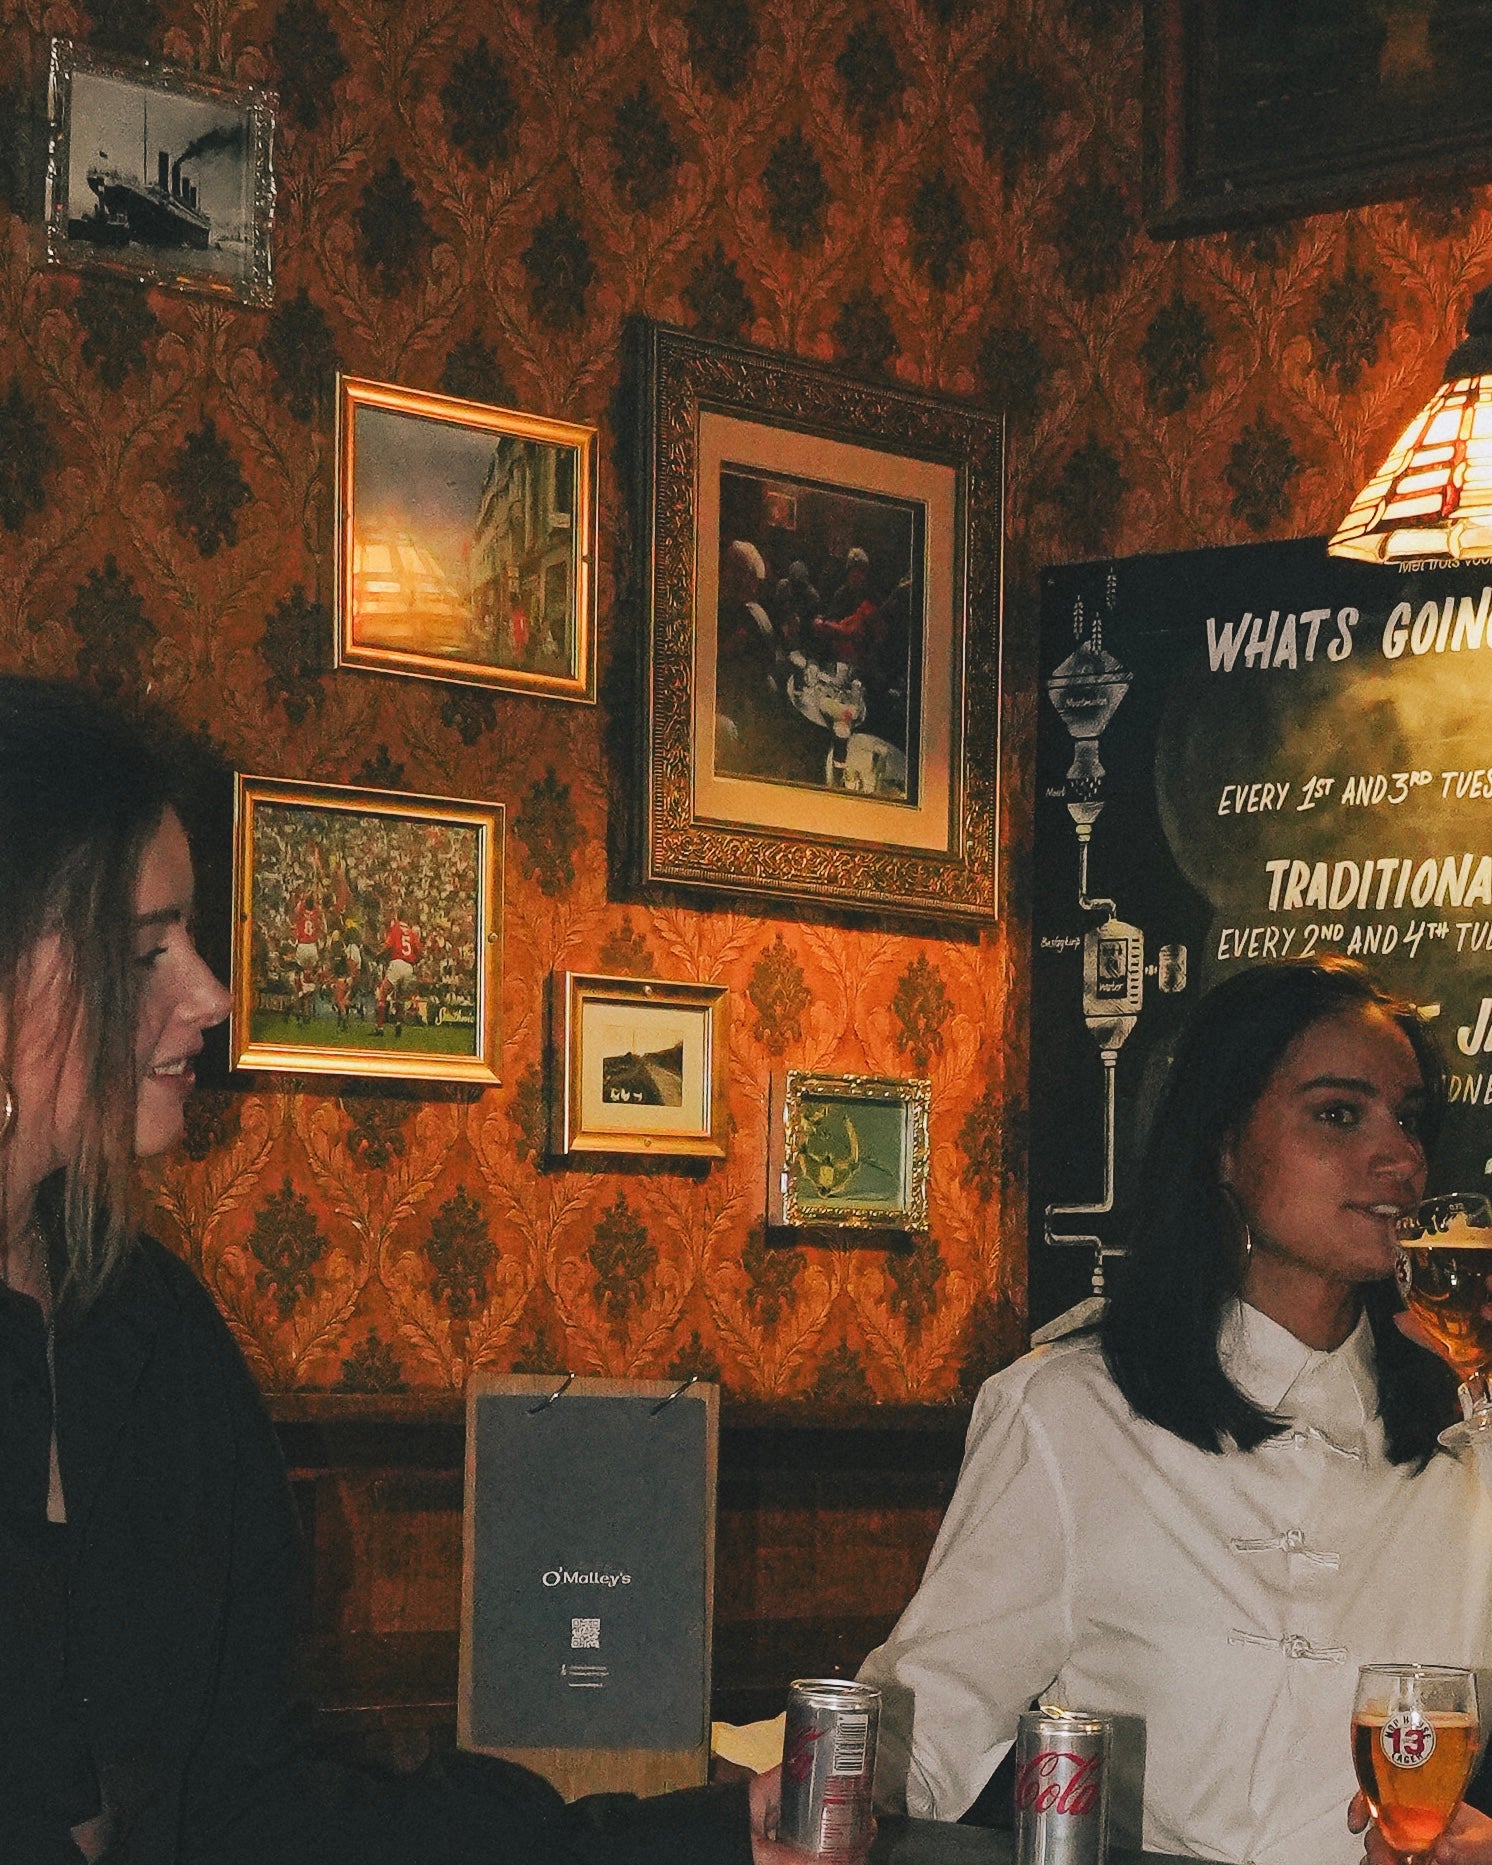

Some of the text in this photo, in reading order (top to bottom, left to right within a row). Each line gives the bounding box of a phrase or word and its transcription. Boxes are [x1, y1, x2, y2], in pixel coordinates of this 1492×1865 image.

[1206, 608, 1359, 673] WHATS
[1217, 781, 1291, 816] EVERY
[1296, 775, 1334, 812] 1ST
[401, 935, 412, 956] 5
[1216, 926, 1297, 961] EVERY
[1302, 922, 1345, 958] 2ND
[1346, 924, 1399, 955] AND
[1403, 921, 1450, 960] 4TH
[542, 1566, 632, 1588] O'Malley's
[1392, 1727, 1426, 1756] 13
[1403, 1715, 1432, 1740] HUSE
